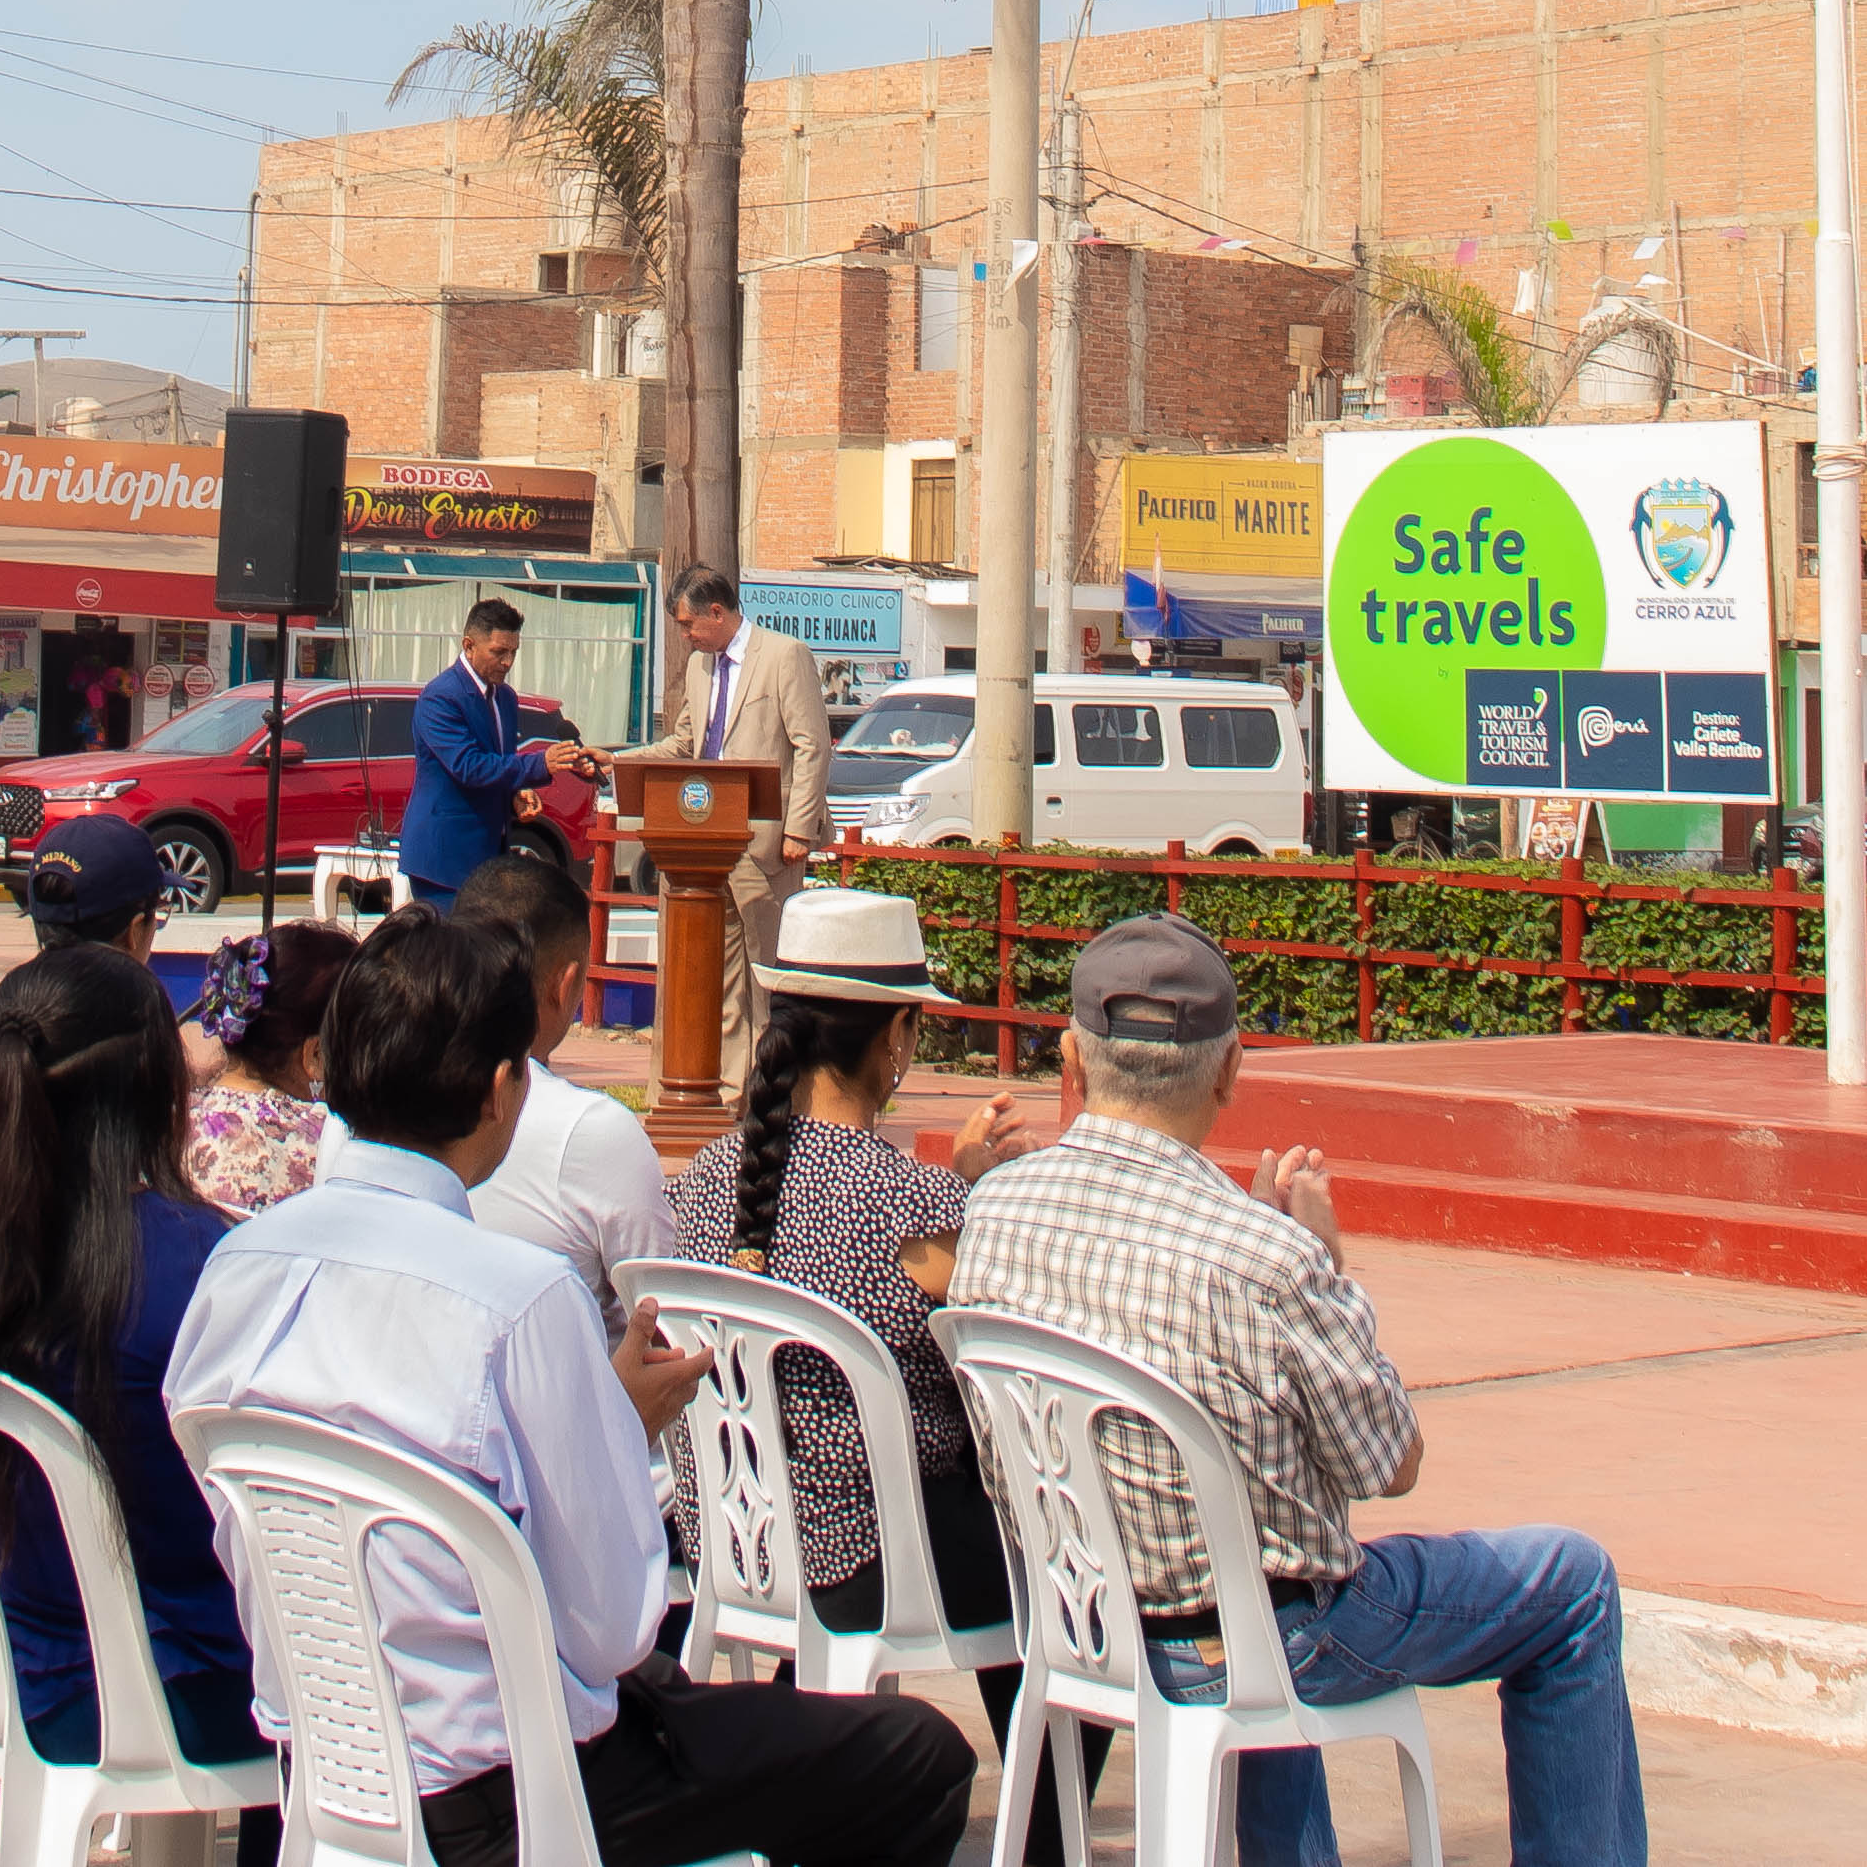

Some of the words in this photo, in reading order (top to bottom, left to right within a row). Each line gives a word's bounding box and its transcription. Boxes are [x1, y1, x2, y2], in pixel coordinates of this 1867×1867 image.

[382, 465, 492, 490] BODEGA
[344, 488, 406, 534] Don
[422, 492, 539, 539] Ernesto
[1234, 498, 1311, 536] MARITE
[1394, 506, 1526, 575] Safe
[742, 589, 834, 608] LABORATORIO
[840, 593, 896, 610] CLINICO
[1360, 577, 1576, 647] travels
[1635, 604, 1690, 620] CERRO
[1694, 604, 1736, 620] AZUL
[804, 616, 820, 640] DE
[824, 618, 878, 643] HUANCA
[1437, 665, 1449, 679] by
[1478, 704, 1534, 720] WORLD
[1692, 710, 1740, 727] Destino:
[1478, 719, 1535, 736] TRAVEL
[1693, 725, 1741, 743] Cañete
[1478, 735, 1548, 752] TOURISM
[1673, 739, 1707, 758] Valle
[1708, 741, 1763, 759] Bendito
[1478, 750, 1550, 767] COUNCIL
[41, 851, 82, 874] MEDRANO
